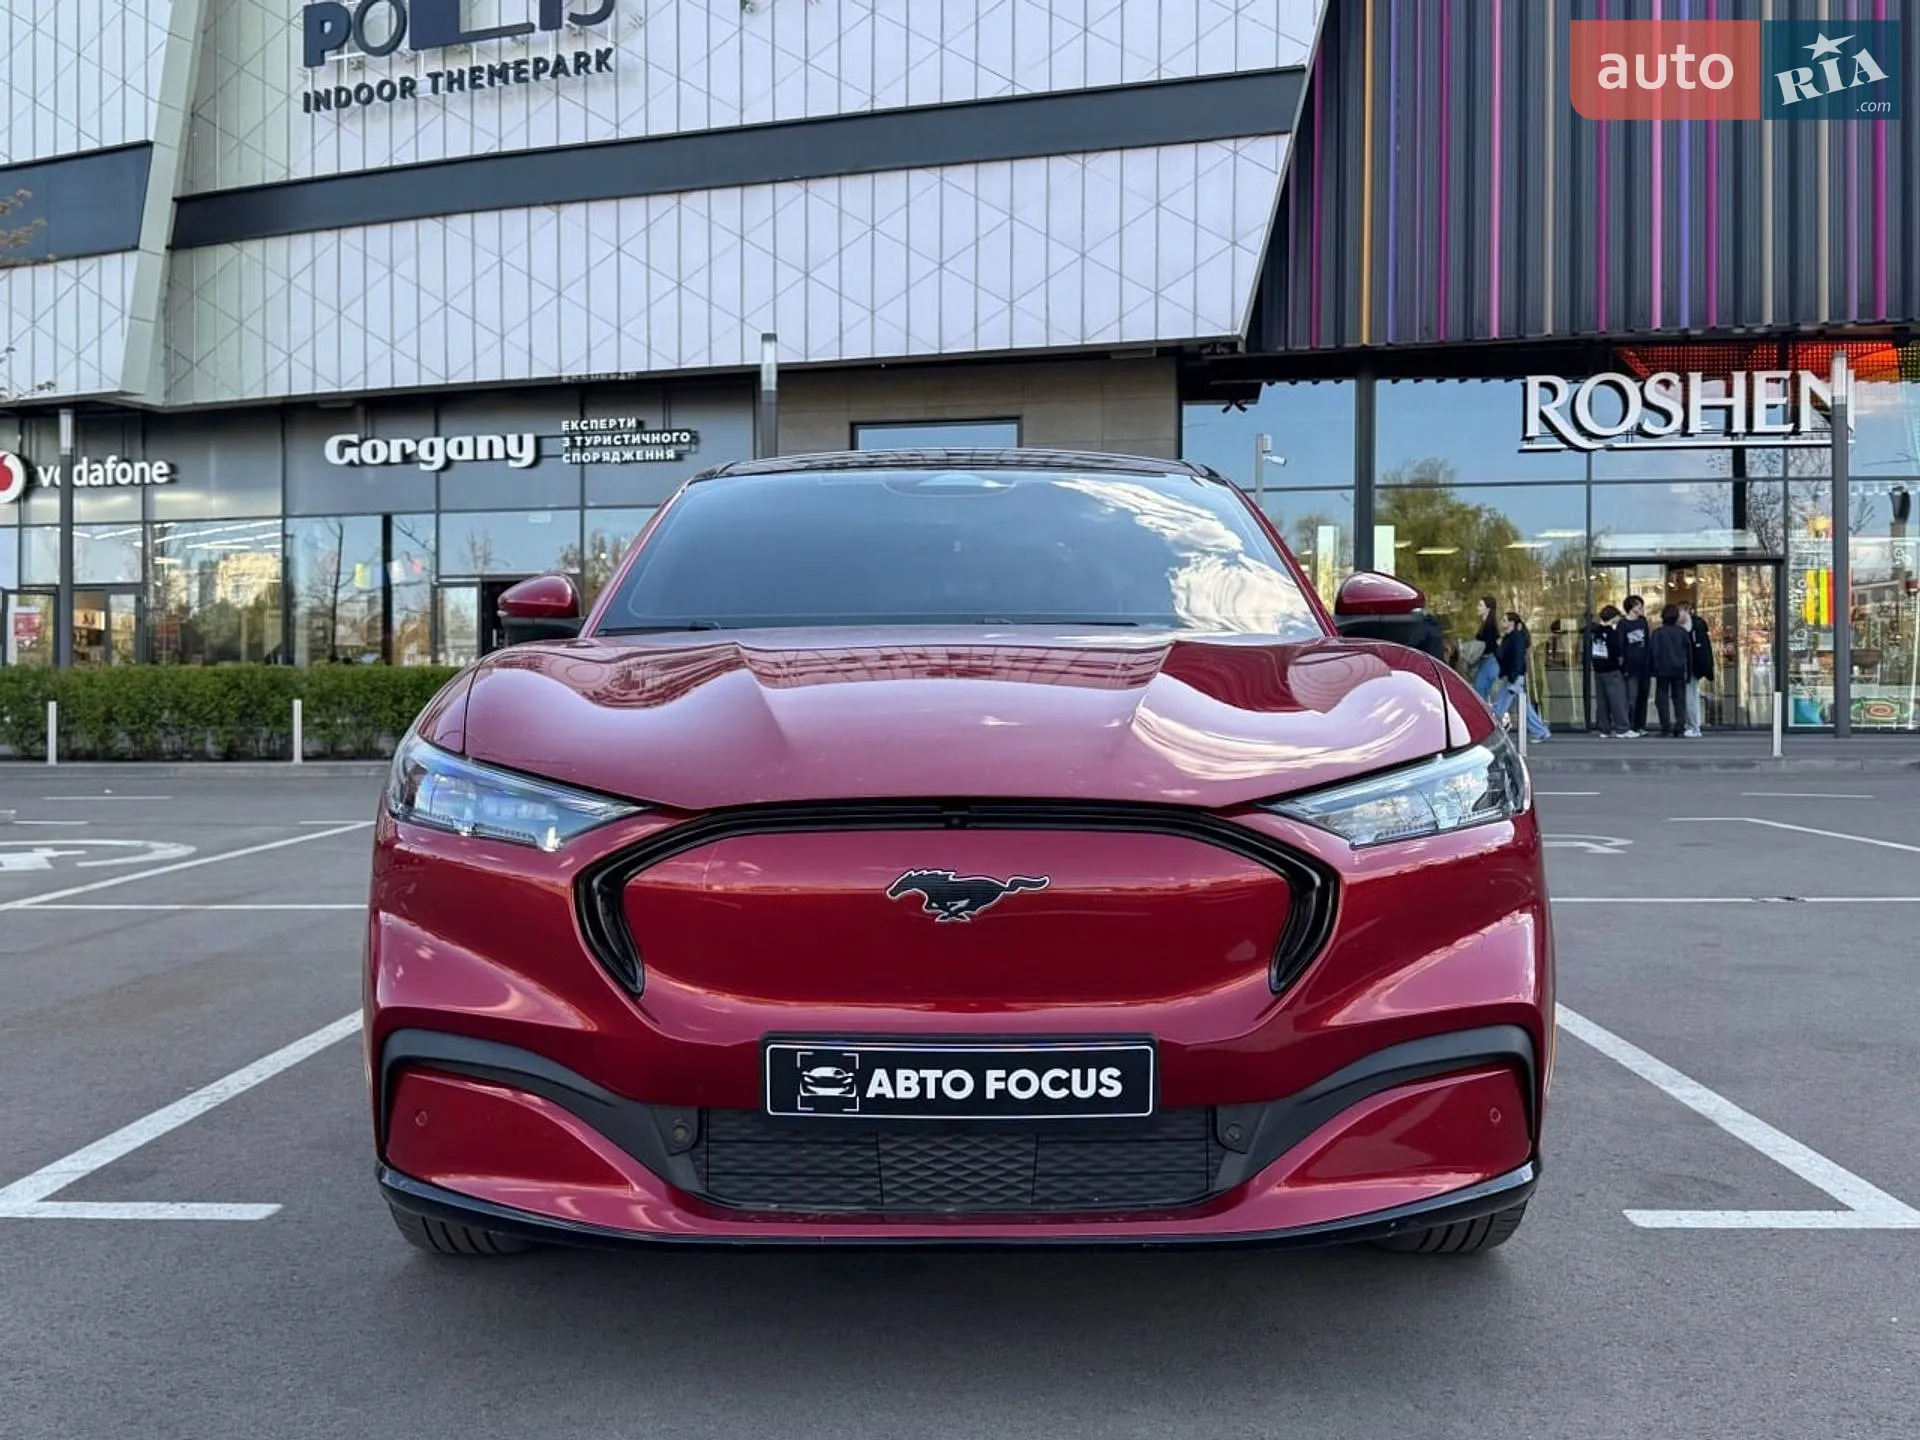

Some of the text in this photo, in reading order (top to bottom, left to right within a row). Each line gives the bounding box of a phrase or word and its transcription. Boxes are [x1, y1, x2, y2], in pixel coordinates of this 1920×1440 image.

[303, 48, 614, 114] INDOOR THEMEPARK
[561, 417, 637, 431] ЕКСПЕРТИ
[1525, 370, 1856, 449] ROSHEN
[324, 433, 536, 471] Gorgany
[575, 431, 691, 447] ТУРИСТИЧНОГО
[562, 449, 676, 464] СПОРЯДЖЕННЯ
[866, 1067, 1123, 1100] АВТО FOCUS
